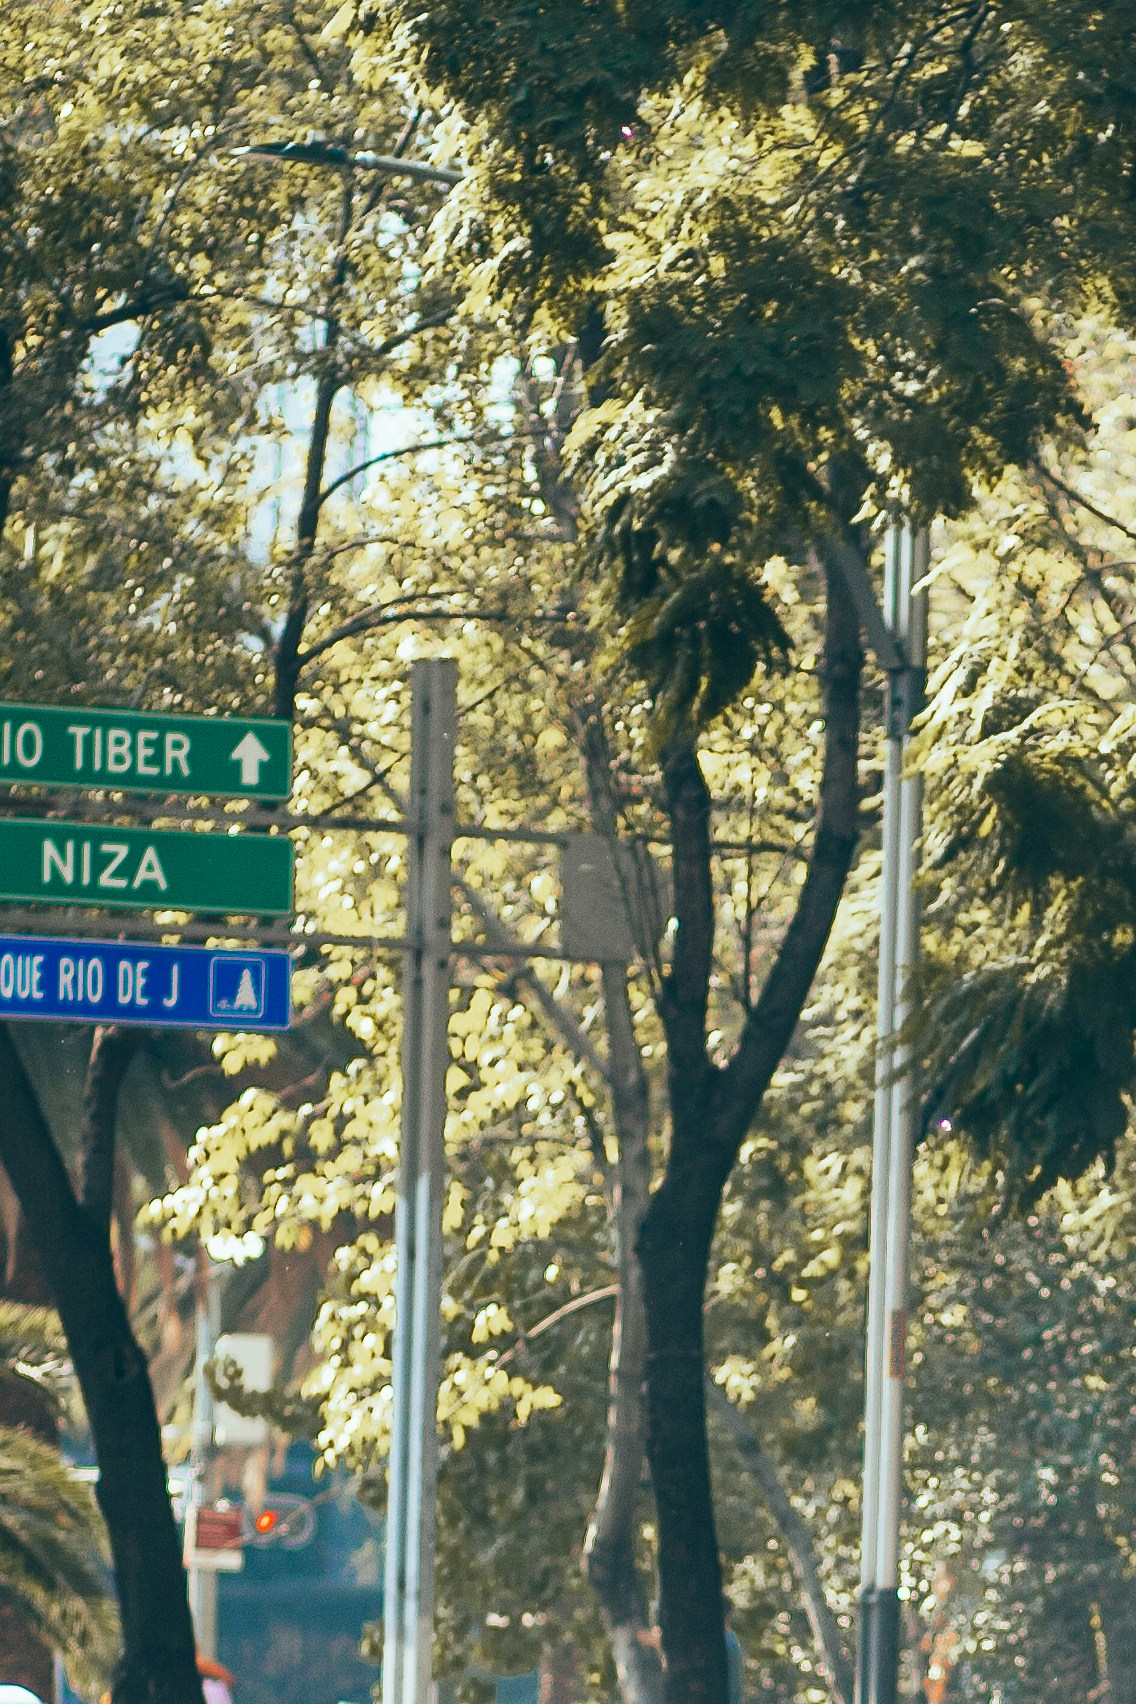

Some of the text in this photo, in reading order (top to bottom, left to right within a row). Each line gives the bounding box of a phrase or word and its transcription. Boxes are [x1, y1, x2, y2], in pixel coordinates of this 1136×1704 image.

[67, 725, 191, 777] TIBER
[42, 839, 168, 891] NIZA
[59, 957, 104, 1003] RIO
[118, 960, 149, 1006] DE
[163, 963, 179, 1008] J
